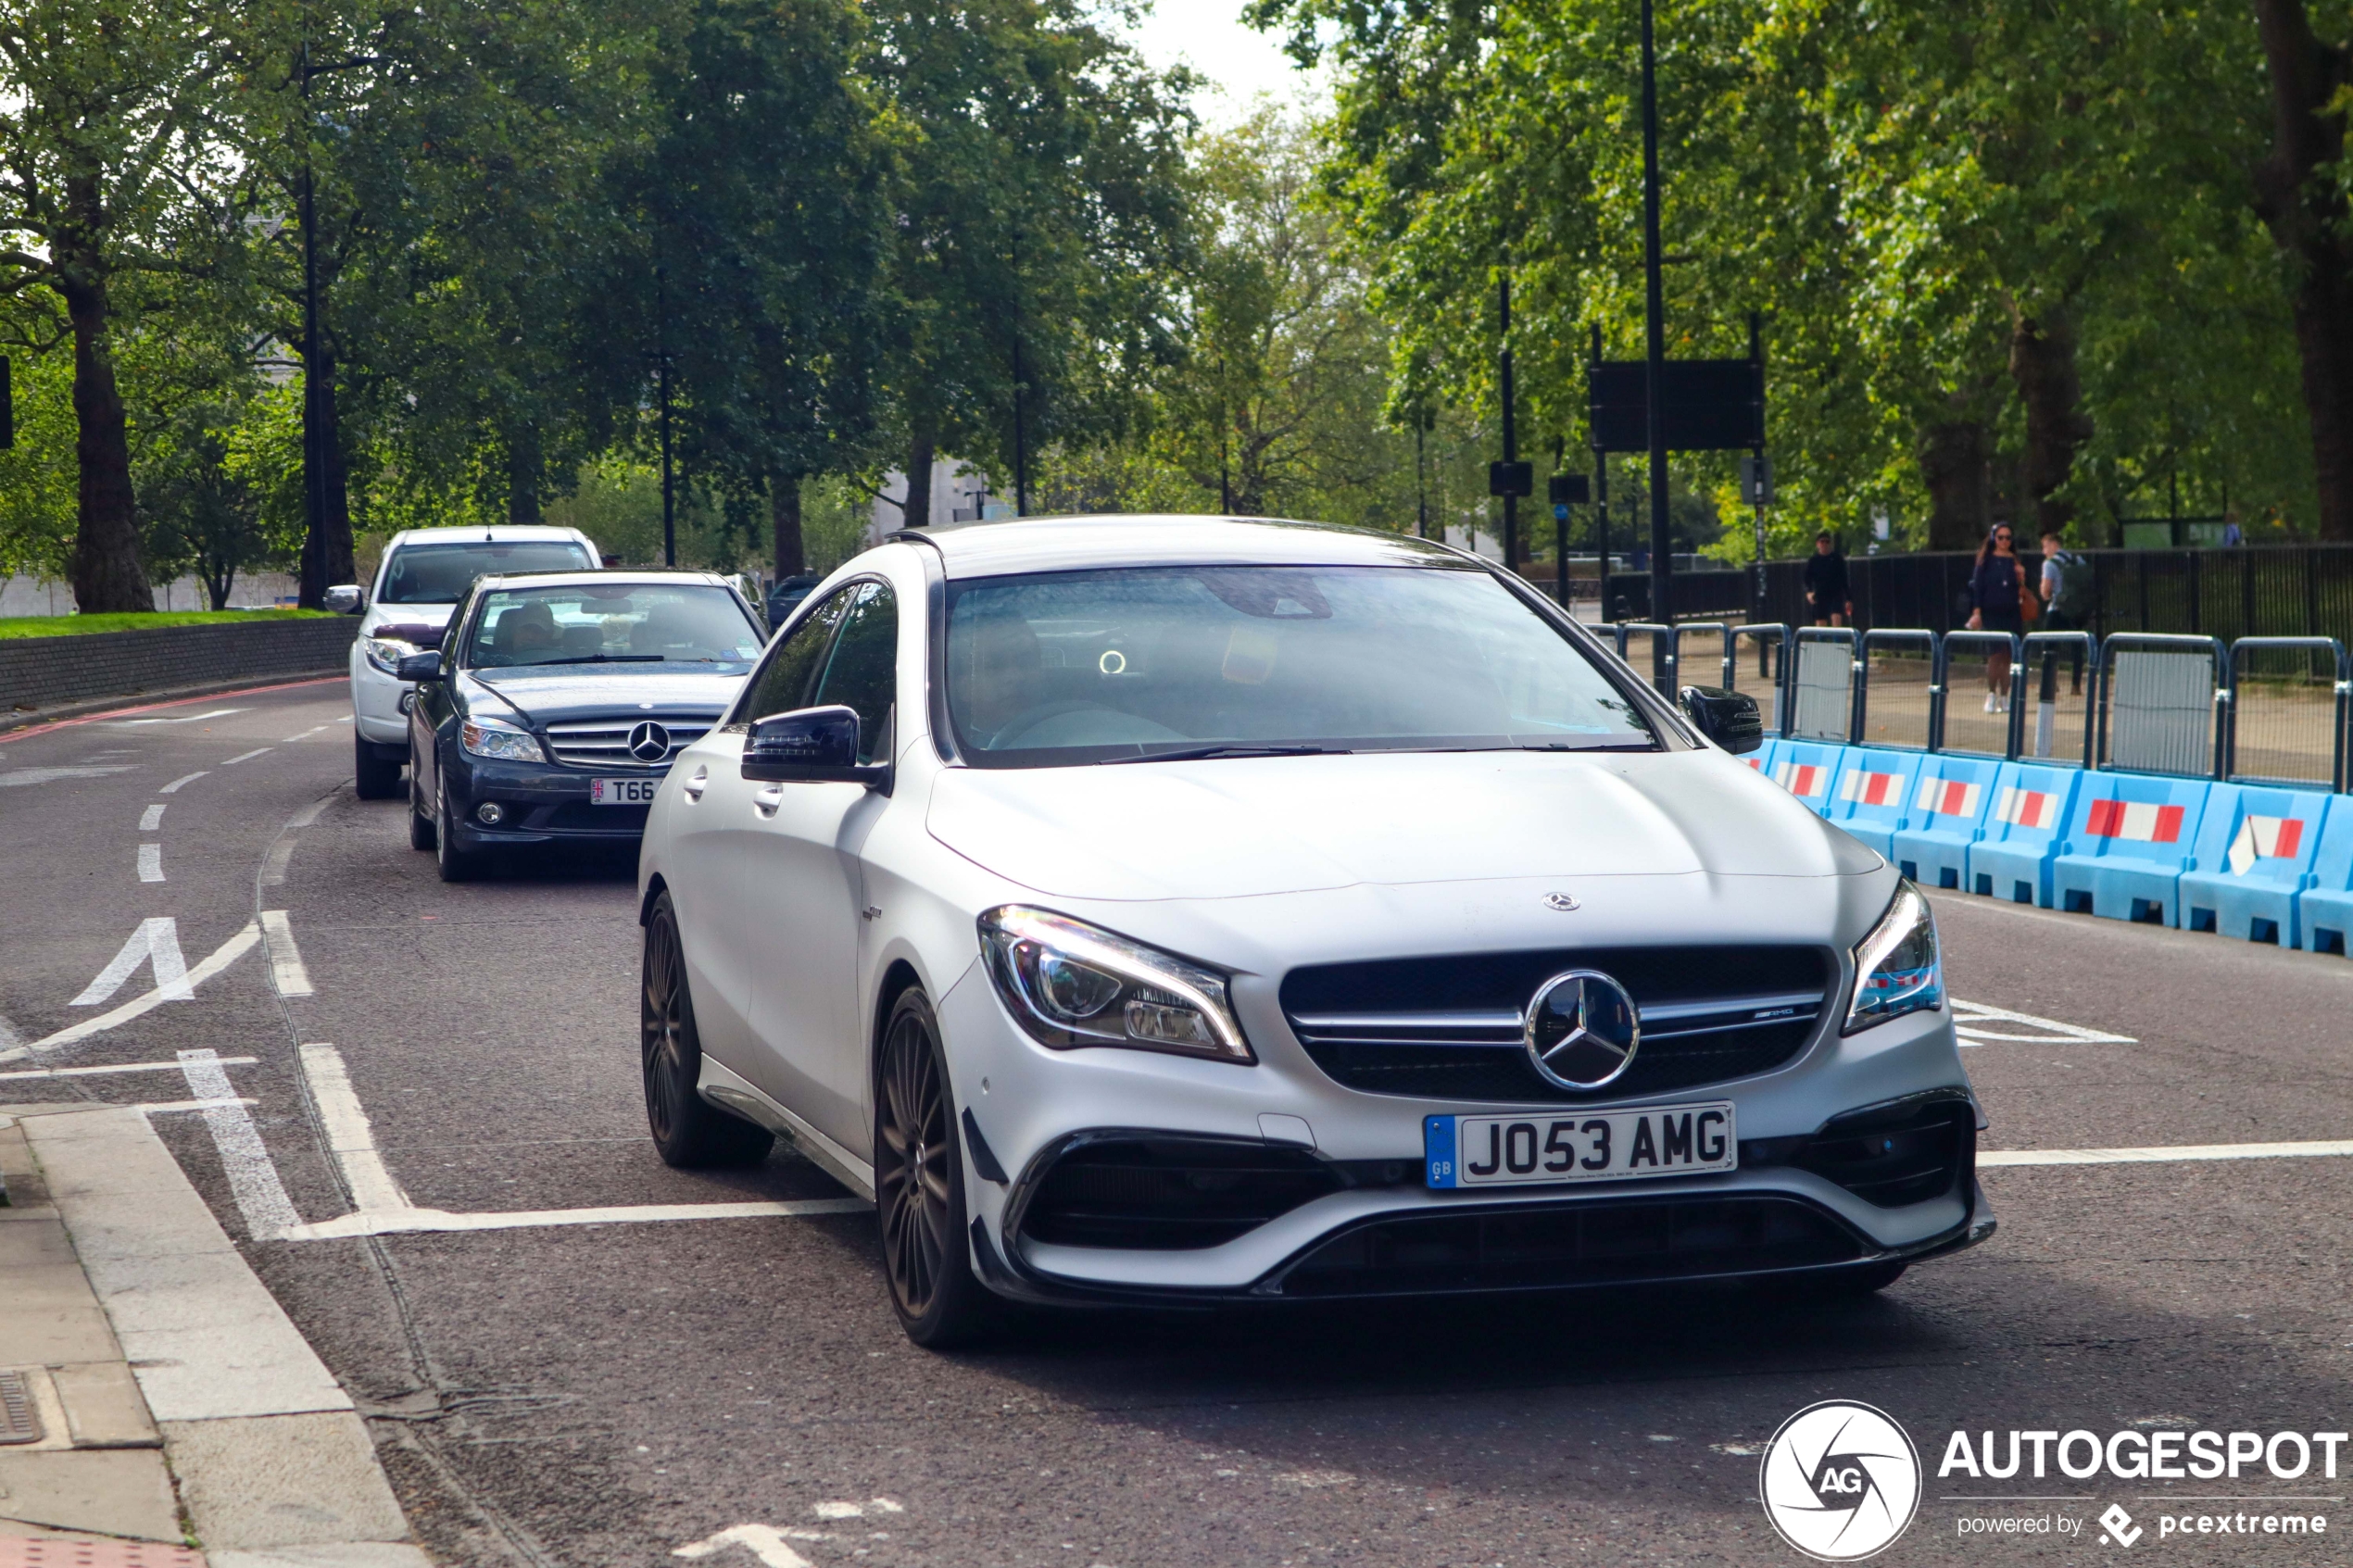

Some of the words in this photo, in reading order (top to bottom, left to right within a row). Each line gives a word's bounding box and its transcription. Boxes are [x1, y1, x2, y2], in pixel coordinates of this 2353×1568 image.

[612, 781, 654, 801] T66
[1629, 1110, 1726, 1169] AMG
[1432, 1160, 1452, 1175] GB
